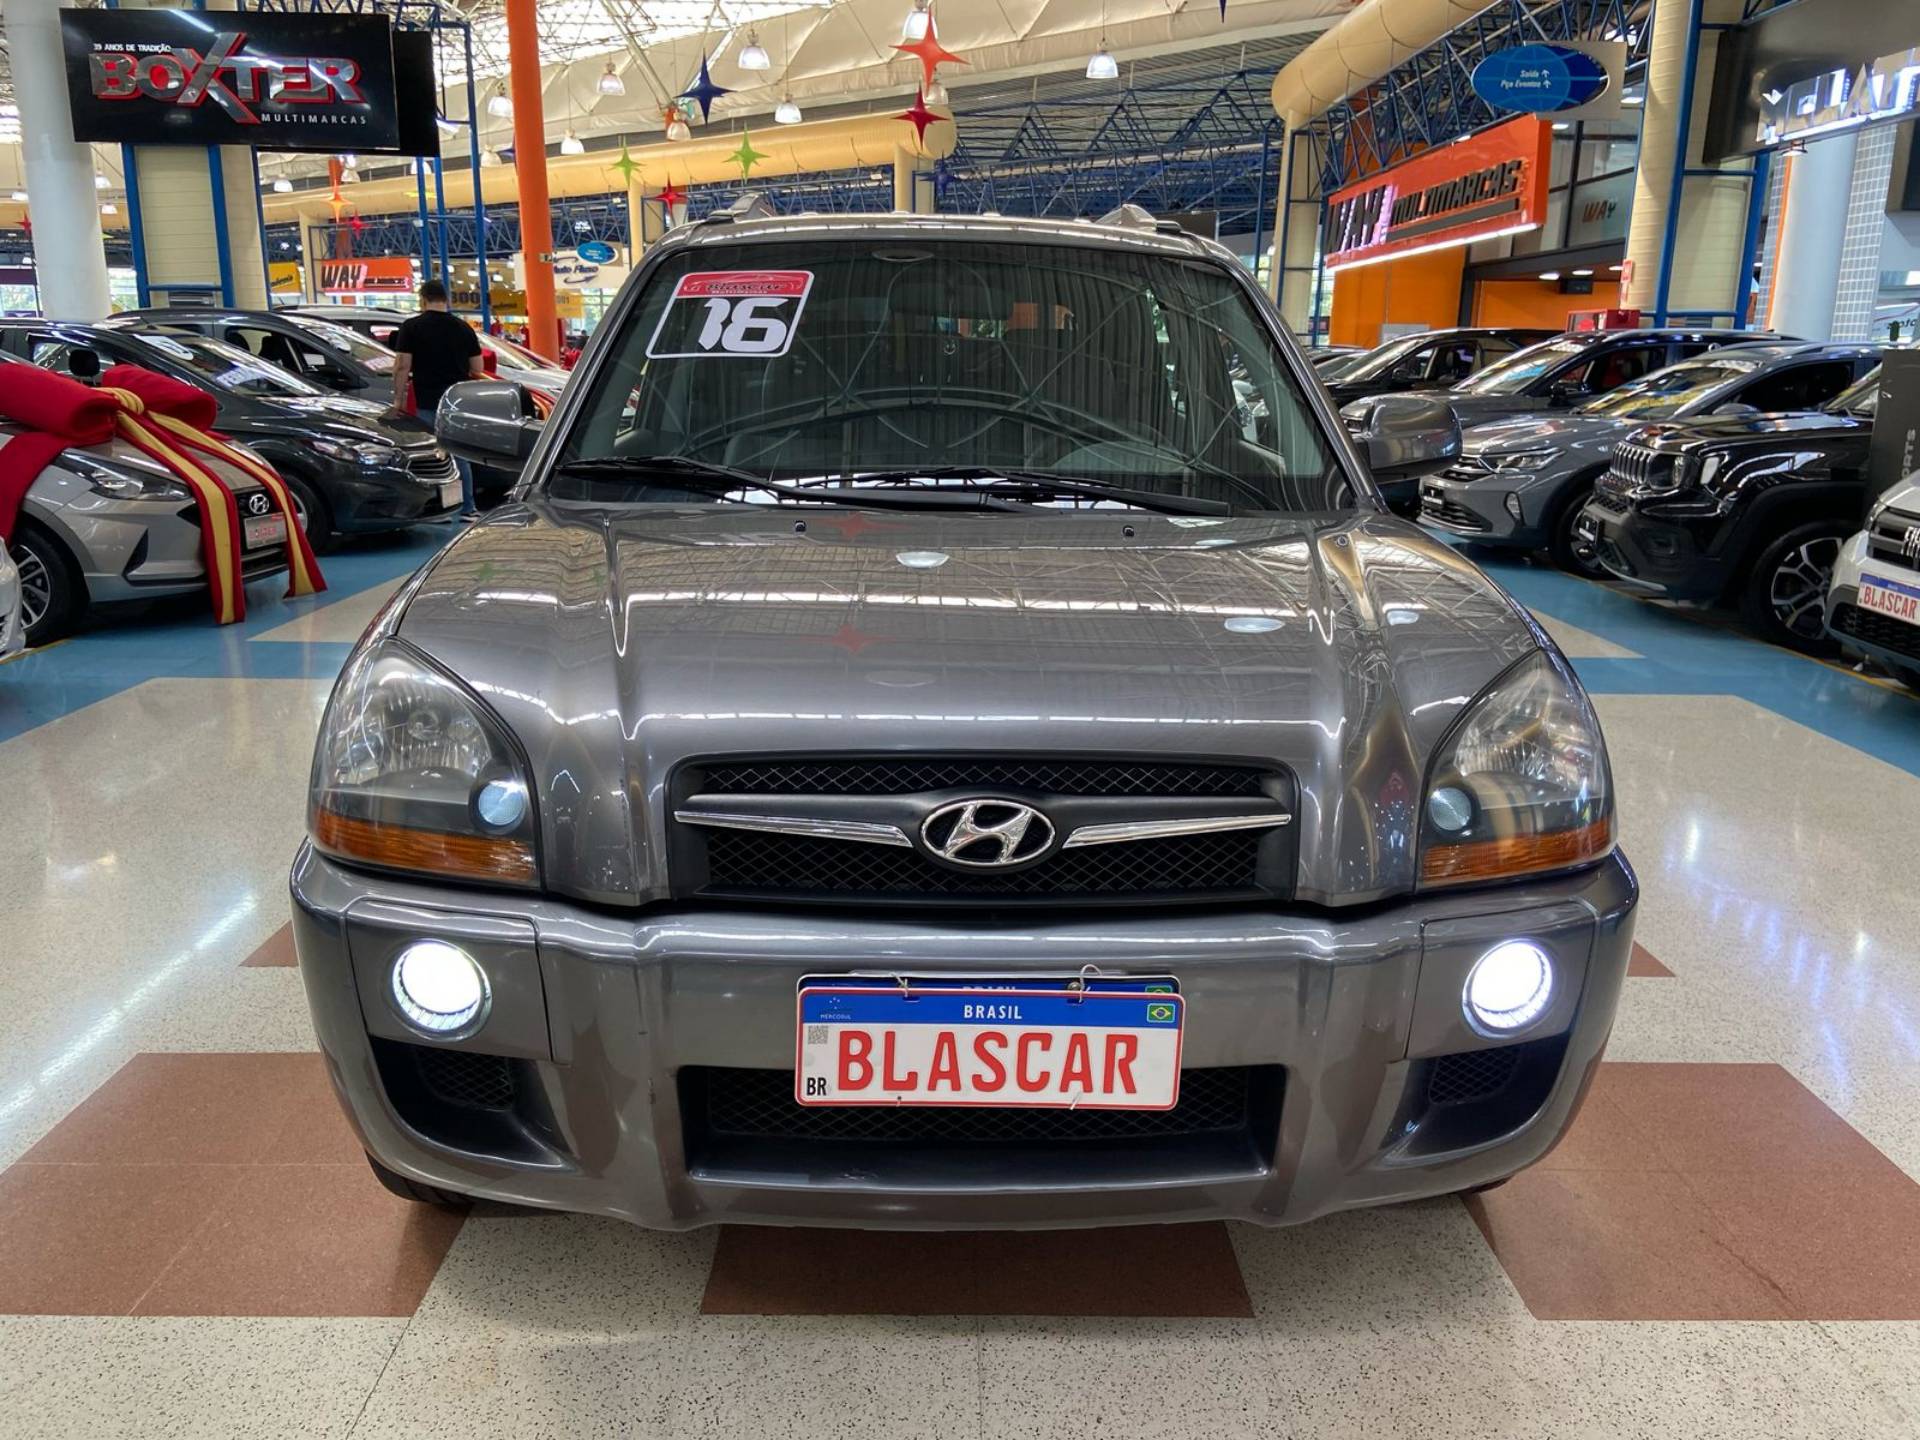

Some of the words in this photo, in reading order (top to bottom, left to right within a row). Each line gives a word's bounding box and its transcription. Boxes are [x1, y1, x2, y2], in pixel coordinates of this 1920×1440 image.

[104, 43, 124, 51] ANOS
[126, 44, 136, 52] DE
[138, 43, 171, 53] TRADIÇÃO
[88, 32, 368, 125] BOXTER
[261, 113, 367, 125] MULTIMARCAS
[1325, 183, 1392, 254] WAY
[1391, 159, 1524, 227] MULTIMARCAS
[1582, 200, 1617, 223] WAY
[321, 264, 362, 289] WAY
[697, 297, 789, 353] 16
[1863, 586, 1918, 620] BLASCAR
[963, 1004, 1023, 1020] BRASIL
[838, 1031, 1139, 1095] BLASCAR
[806, 1076, 828, 1096] BR
